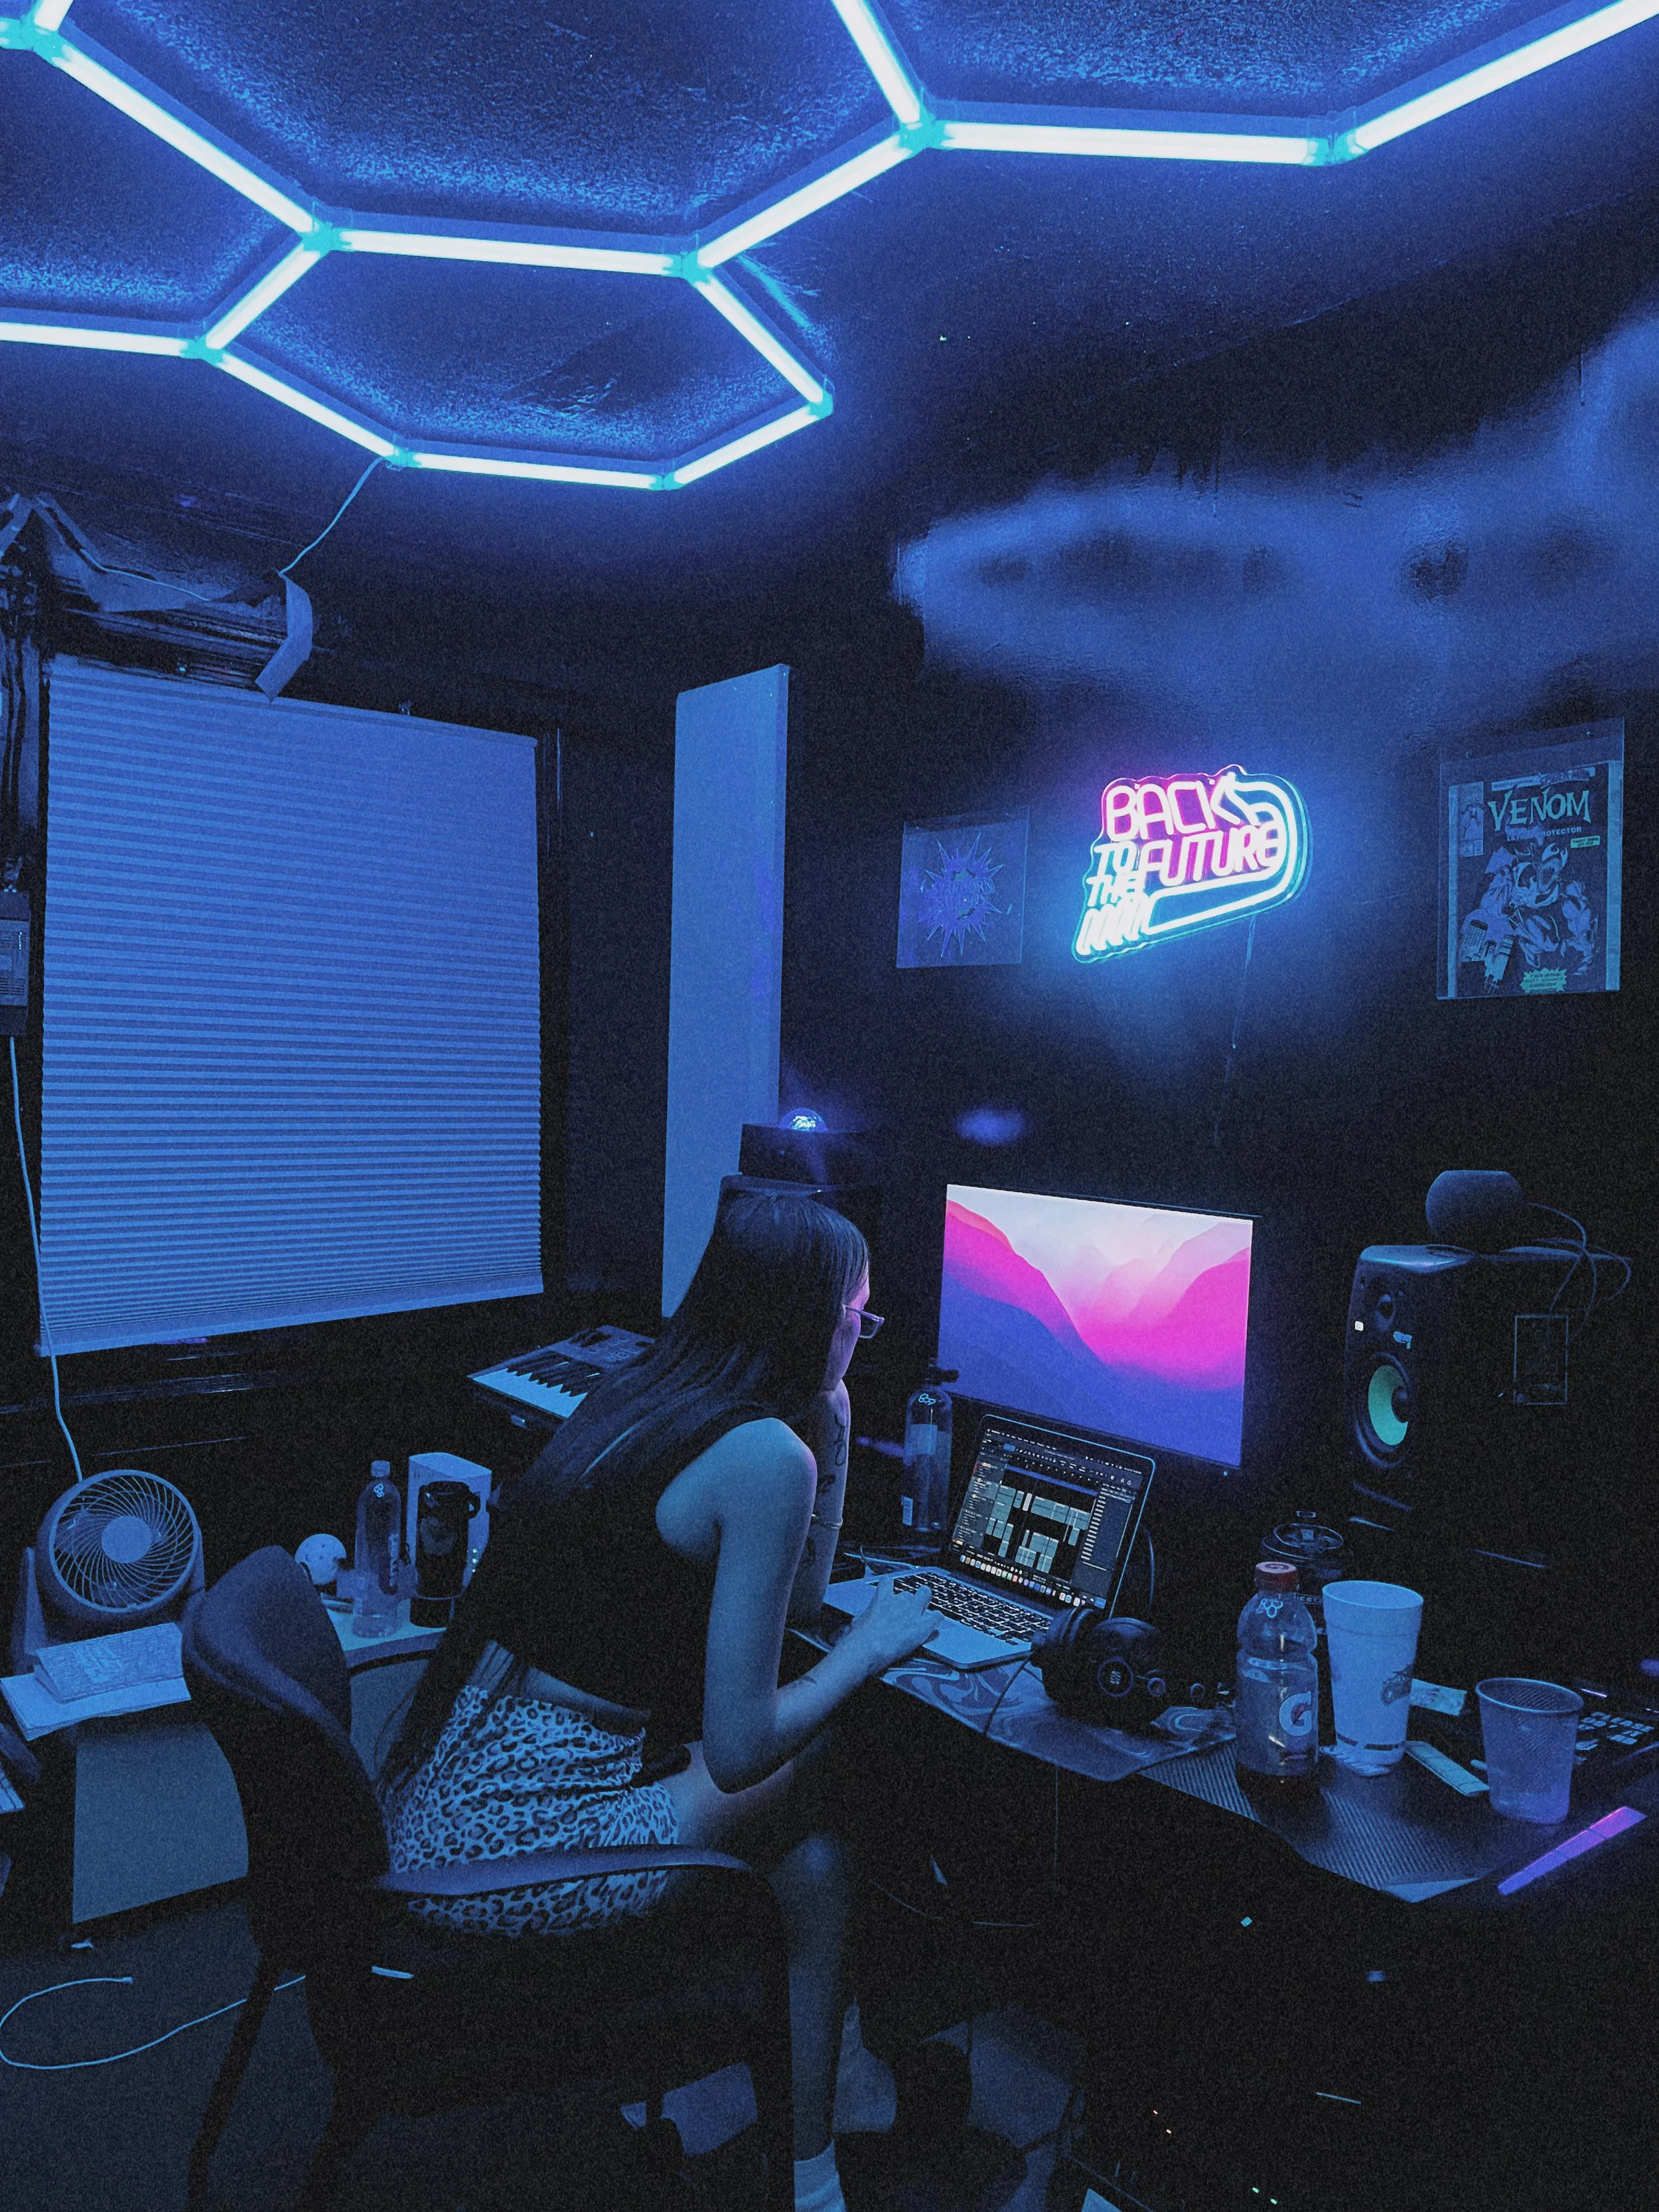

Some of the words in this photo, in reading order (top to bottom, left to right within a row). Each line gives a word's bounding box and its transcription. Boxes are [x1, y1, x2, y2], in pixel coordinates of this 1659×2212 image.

[1106, 772, 1241, 842] BACK
[1487, 786, 1591, 831] VENOM
[1094, 841, 1137, 875] TO
[1137, 822, 1280, 890] FUTURE
[1086, 870, 1143, 907] THE
[1279, 1691, 1313, 1736] G
